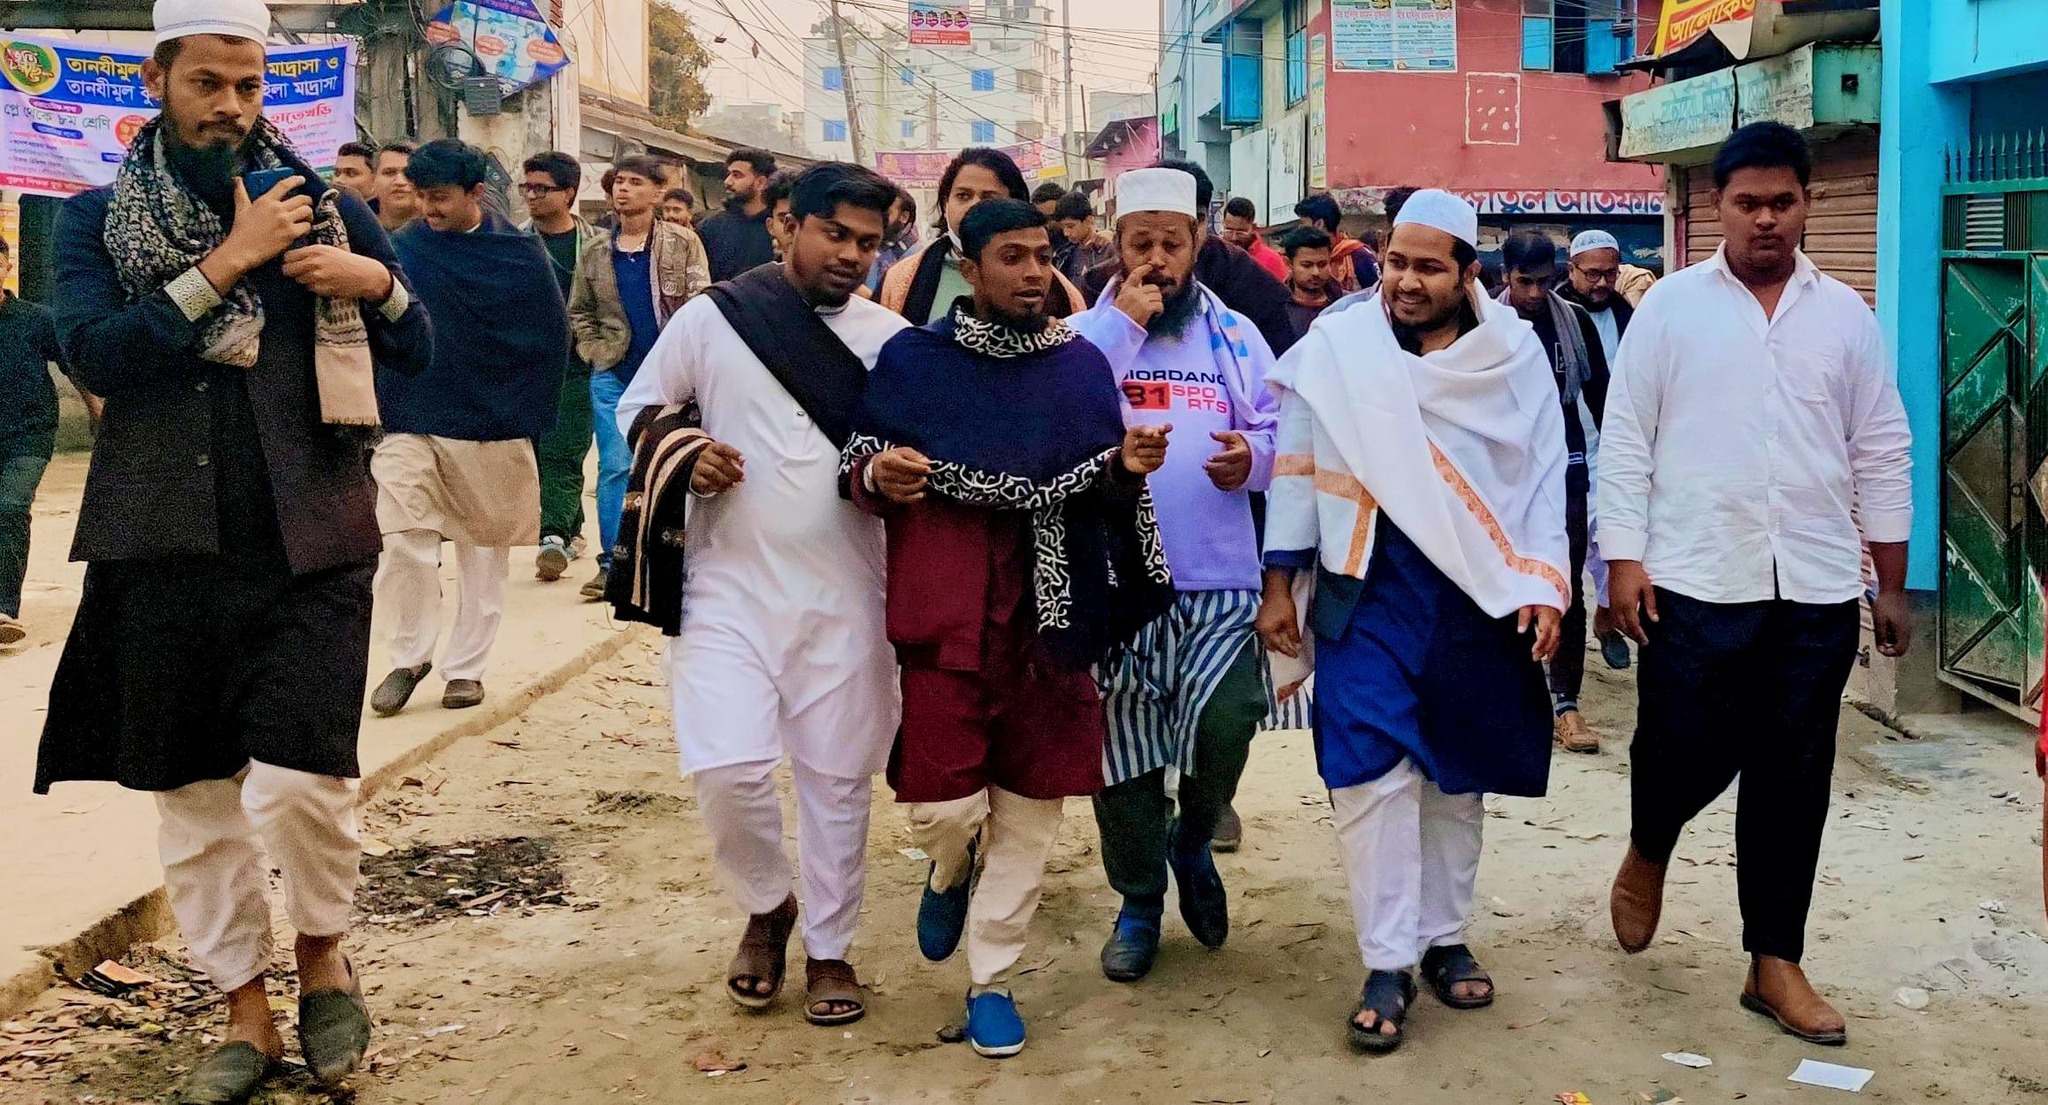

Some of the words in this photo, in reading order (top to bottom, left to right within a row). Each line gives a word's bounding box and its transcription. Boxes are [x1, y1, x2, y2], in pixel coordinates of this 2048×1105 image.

[326, 56, 340, 69] ও
[65, 77, 136, 103] তানযীমুল
[292, 75, 339, 96] মাদ্রাসা
[1462, 189, 1547, 214] জাতুল
[1171, 384, 1216, 399] SPO
[1188, 398, 1227, 413] RTS
